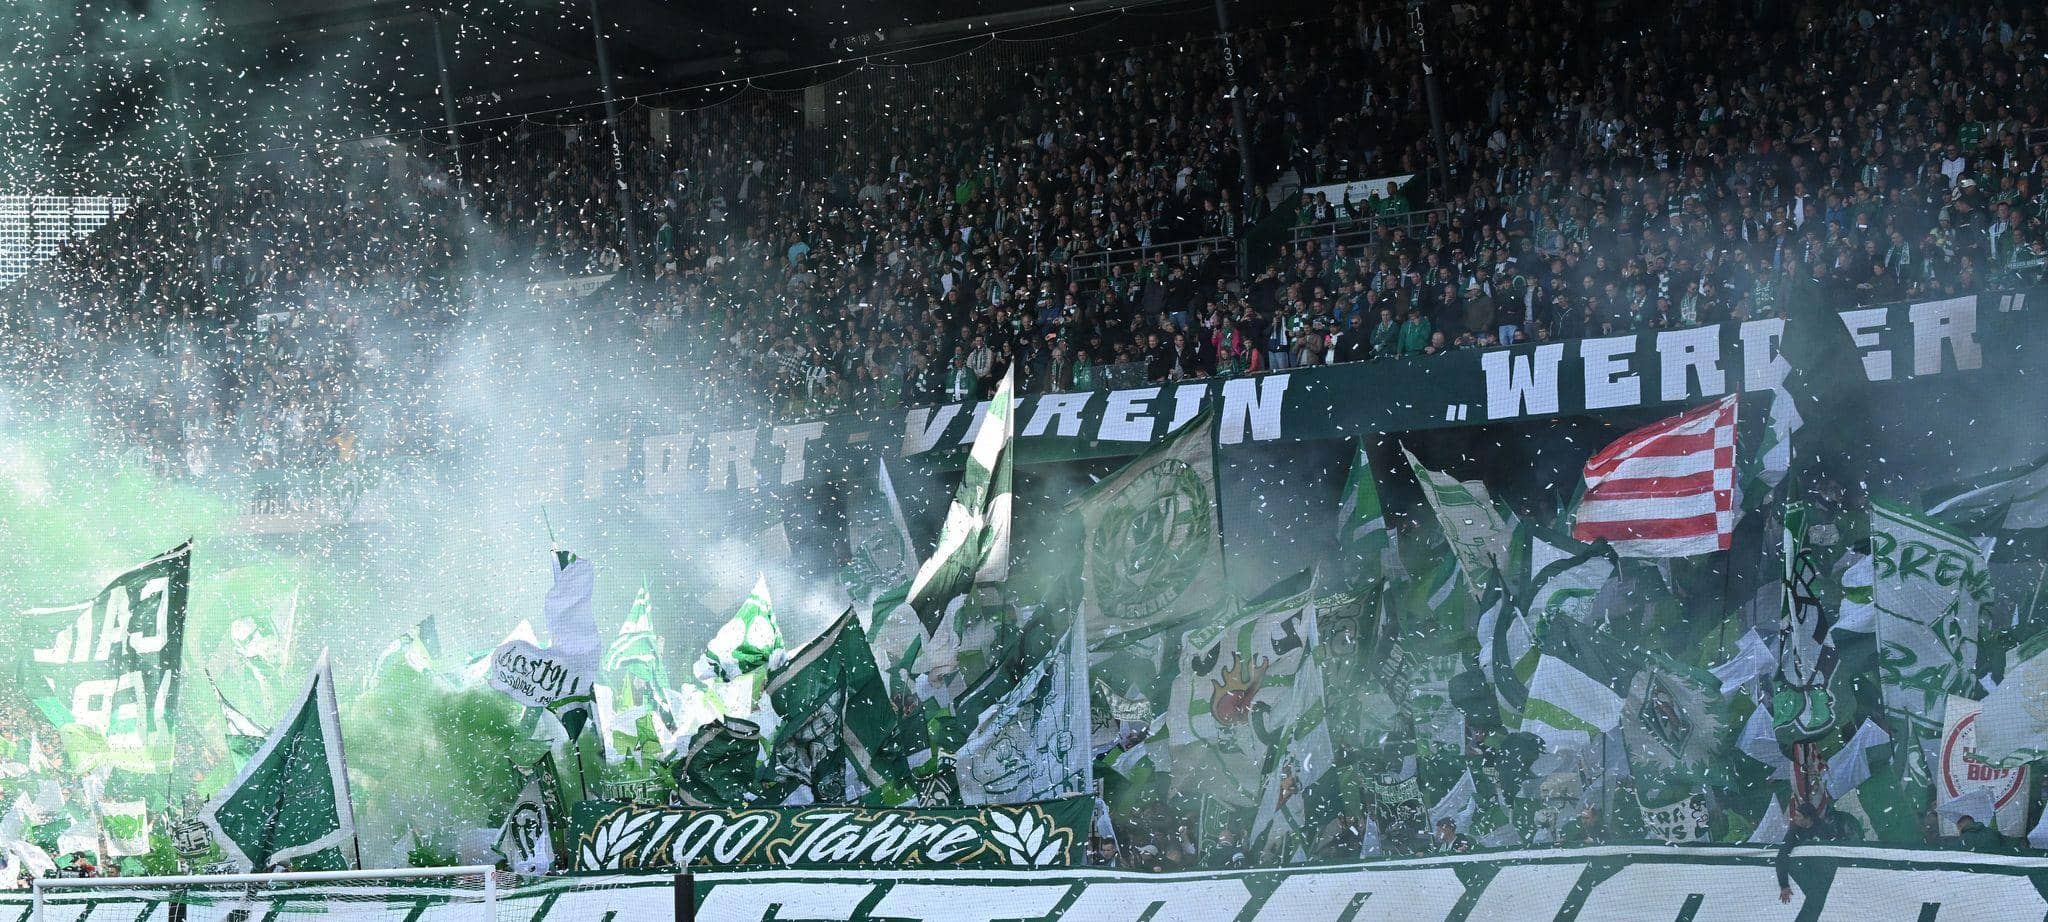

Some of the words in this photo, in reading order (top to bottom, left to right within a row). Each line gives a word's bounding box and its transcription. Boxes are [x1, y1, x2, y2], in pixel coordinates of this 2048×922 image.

[1223, 37, 1235, 76] 133
[453, 150, 463, 190] 137
[611, 130, 622, 170] 135
[640, 813, 767, 867] 100
[780, 811, 979, 867] Jahre
